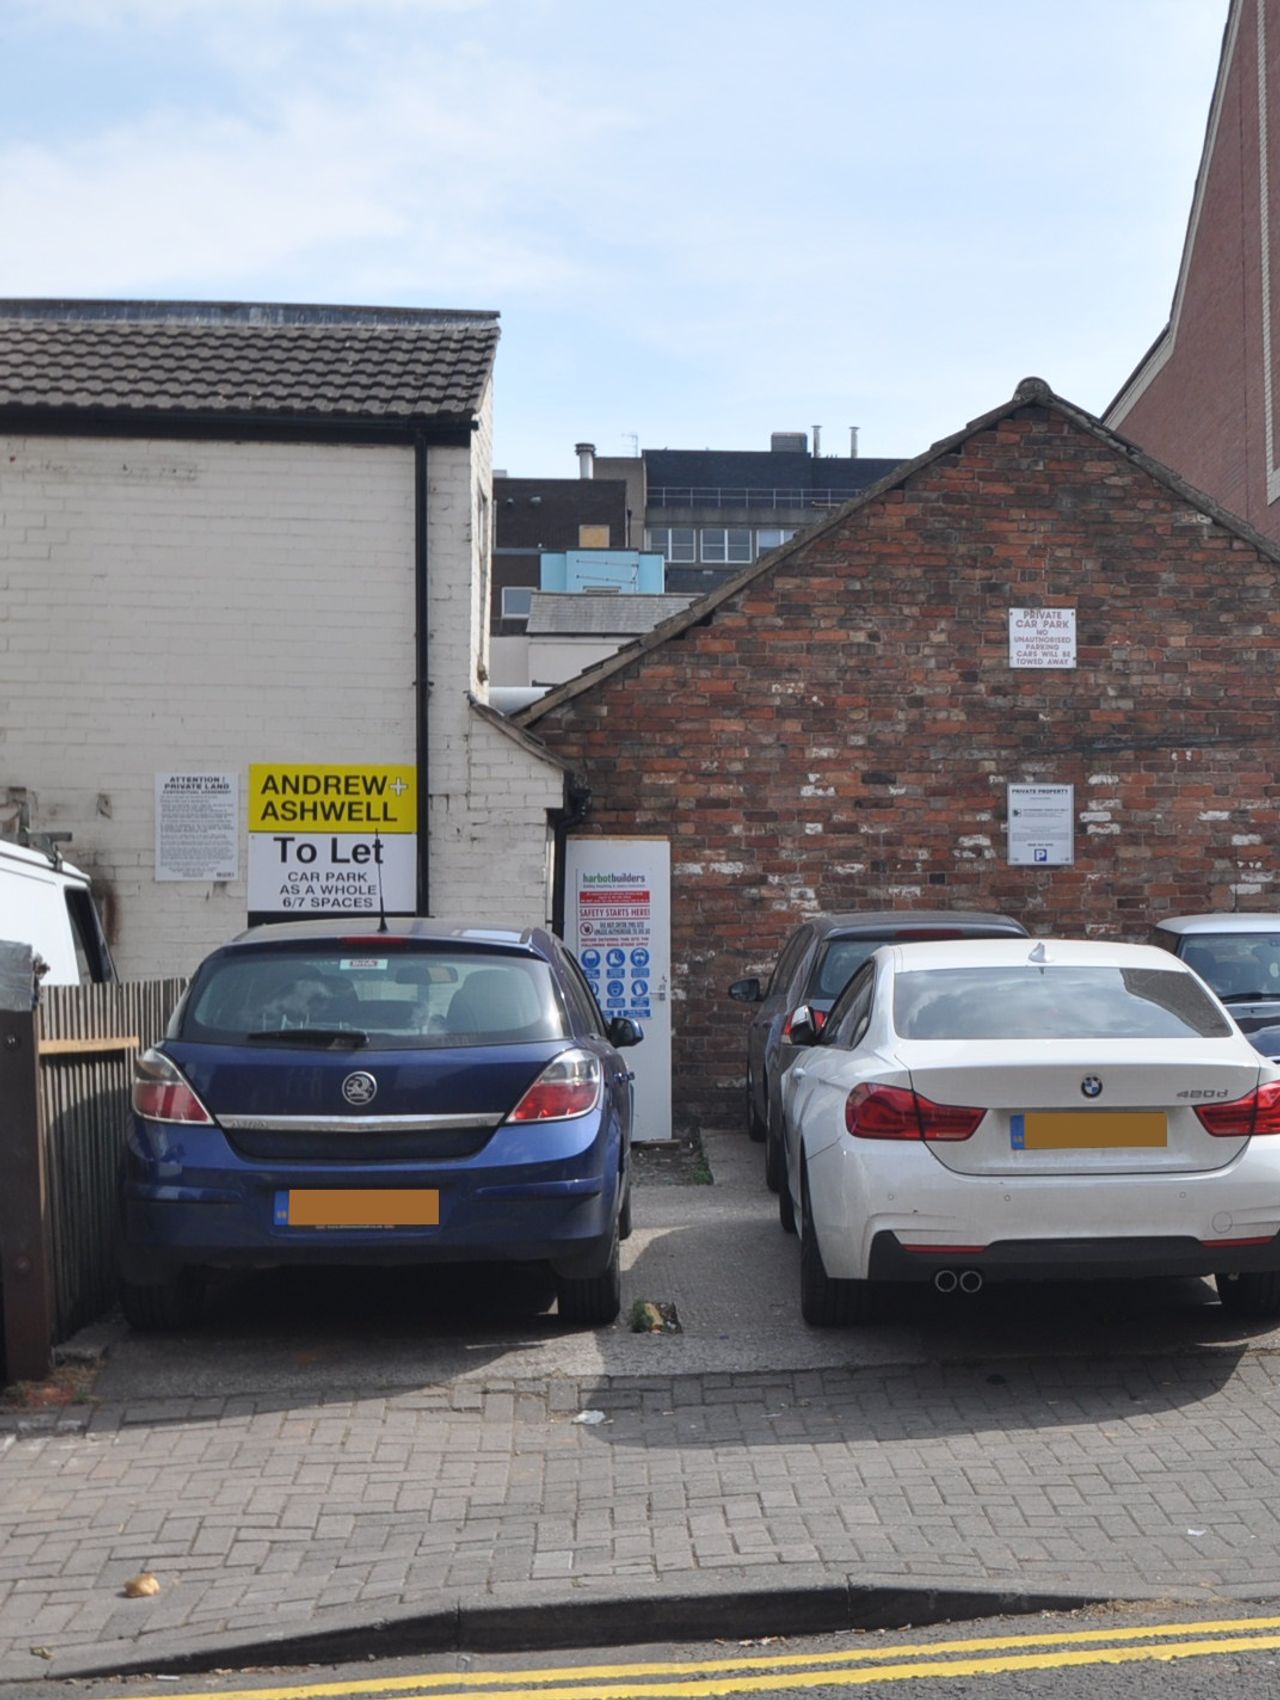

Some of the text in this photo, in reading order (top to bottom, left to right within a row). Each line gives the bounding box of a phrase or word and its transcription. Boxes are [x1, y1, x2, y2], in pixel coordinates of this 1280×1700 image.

[1023, 611, 1062, 619] PRIVATE
[1015, 620, 1069, 628] CAR PARK
[260, 775, 388, 795] ANDREW
[260, 801, 398, 822] ASHWELL
[273, 837, 384, 865] To Let
[288, 872, 368, 883] CAR PARK
[583, 872, 646, 883] harbotbuilders
[279, 884, 377, 896] AS A WHOLE
[282, 897, 373, 909] 6/7 SPACES
[580, 908, 651, 917] SAFETY STARTS HERE!
[1176, 1089, 1229, 1098] 420d
